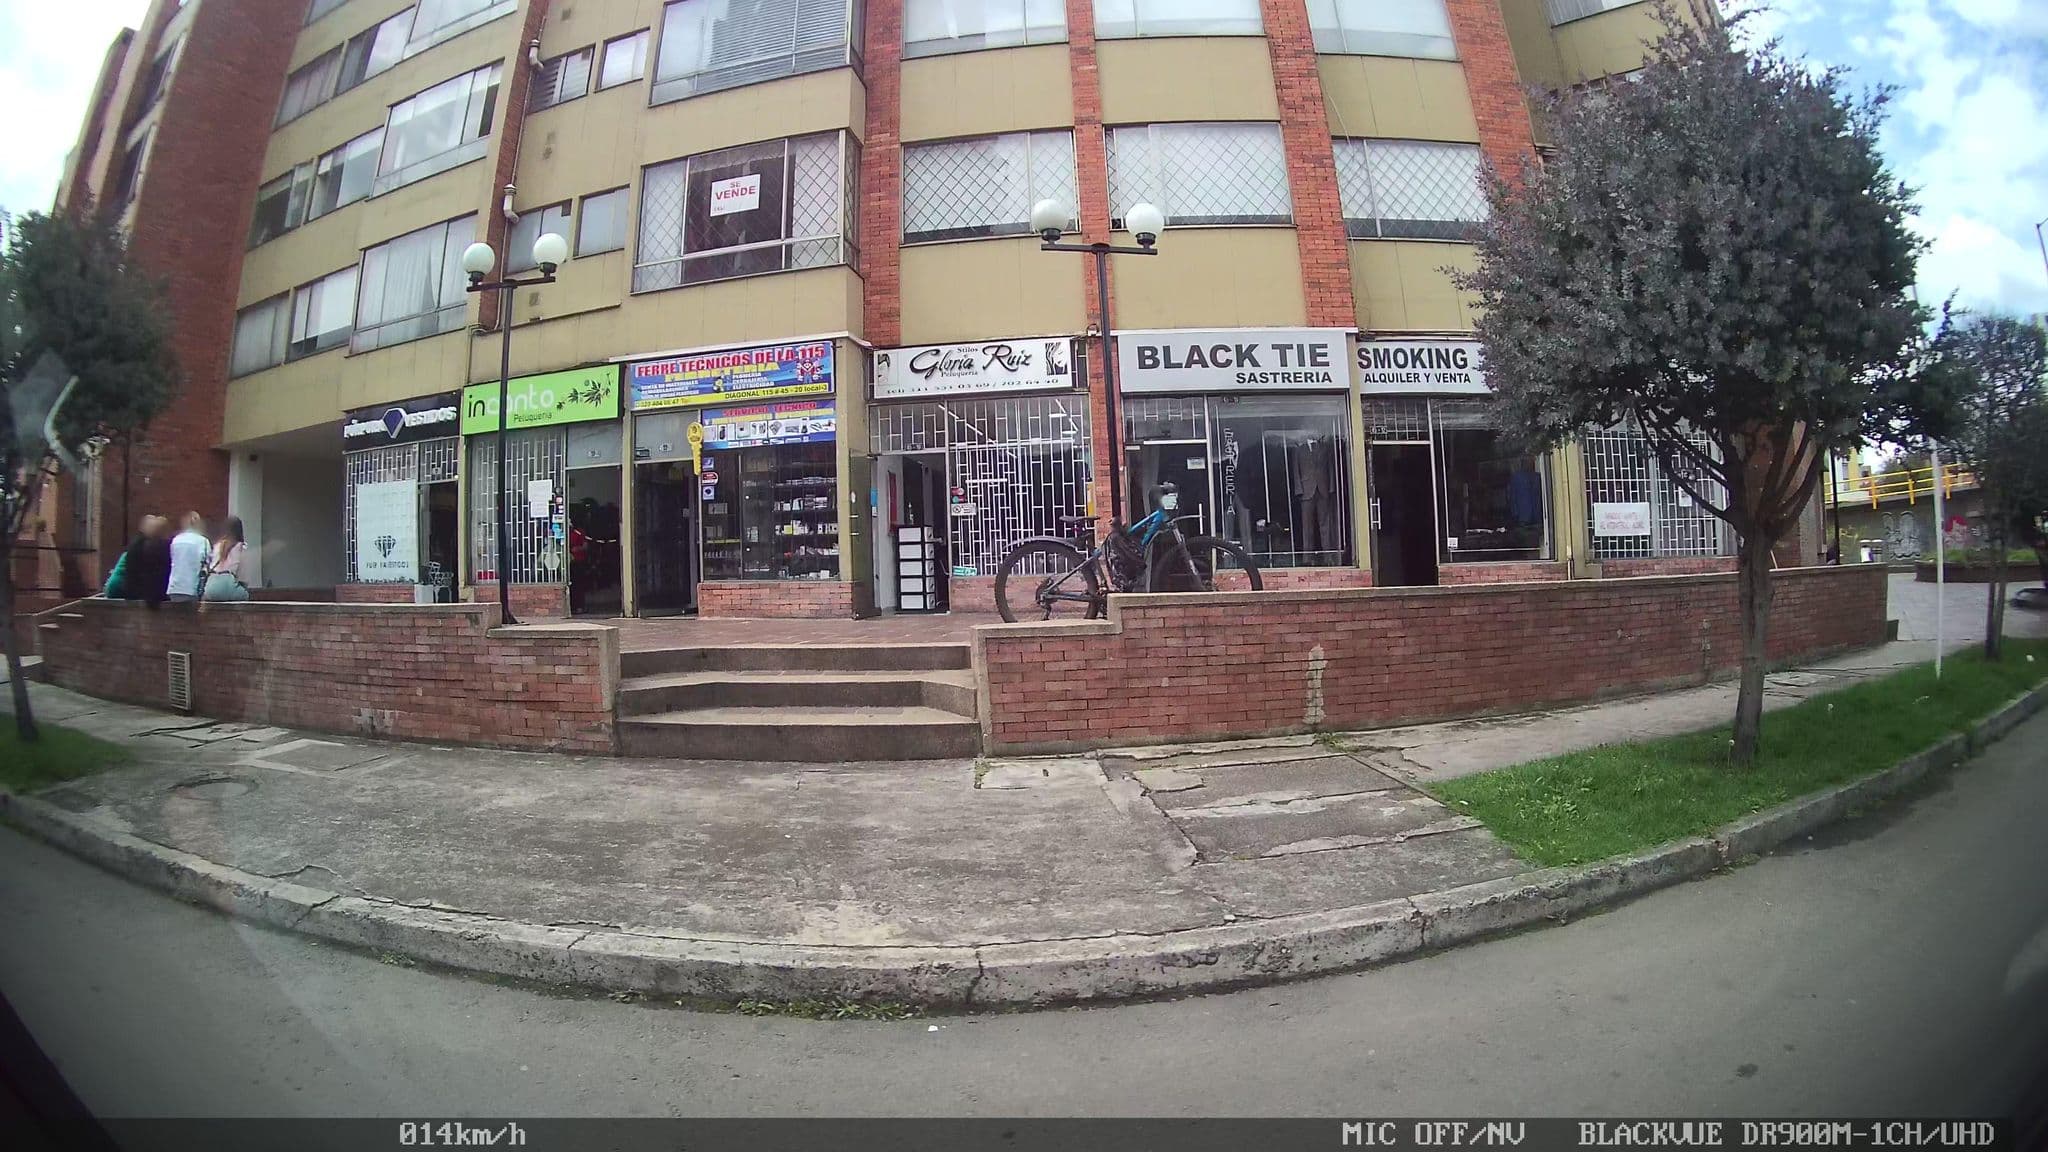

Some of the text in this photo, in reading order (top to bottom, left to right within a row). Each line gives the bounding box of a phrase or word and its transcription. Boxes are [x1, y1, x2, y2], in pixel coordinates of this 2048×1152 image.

[715, 185, 757, 200] VENDE
[635, 343, 826, 378] FERRE TECNICOS DE LA 115
[909, 343, 1033, 380] Gloria Ruiz
[1136, 342, 1331, 370] BLACK TIE
[1357, 347, 1468, 370] SMOKING
[1236, 371, 1333, 385] SASTRERIA
[1364, 372, 1472, 385] ALQUILER Y VENTA
[725, 392, 760, 400] DIAGONAL
[1223, 427, 1236, 515] SASTRERIA
